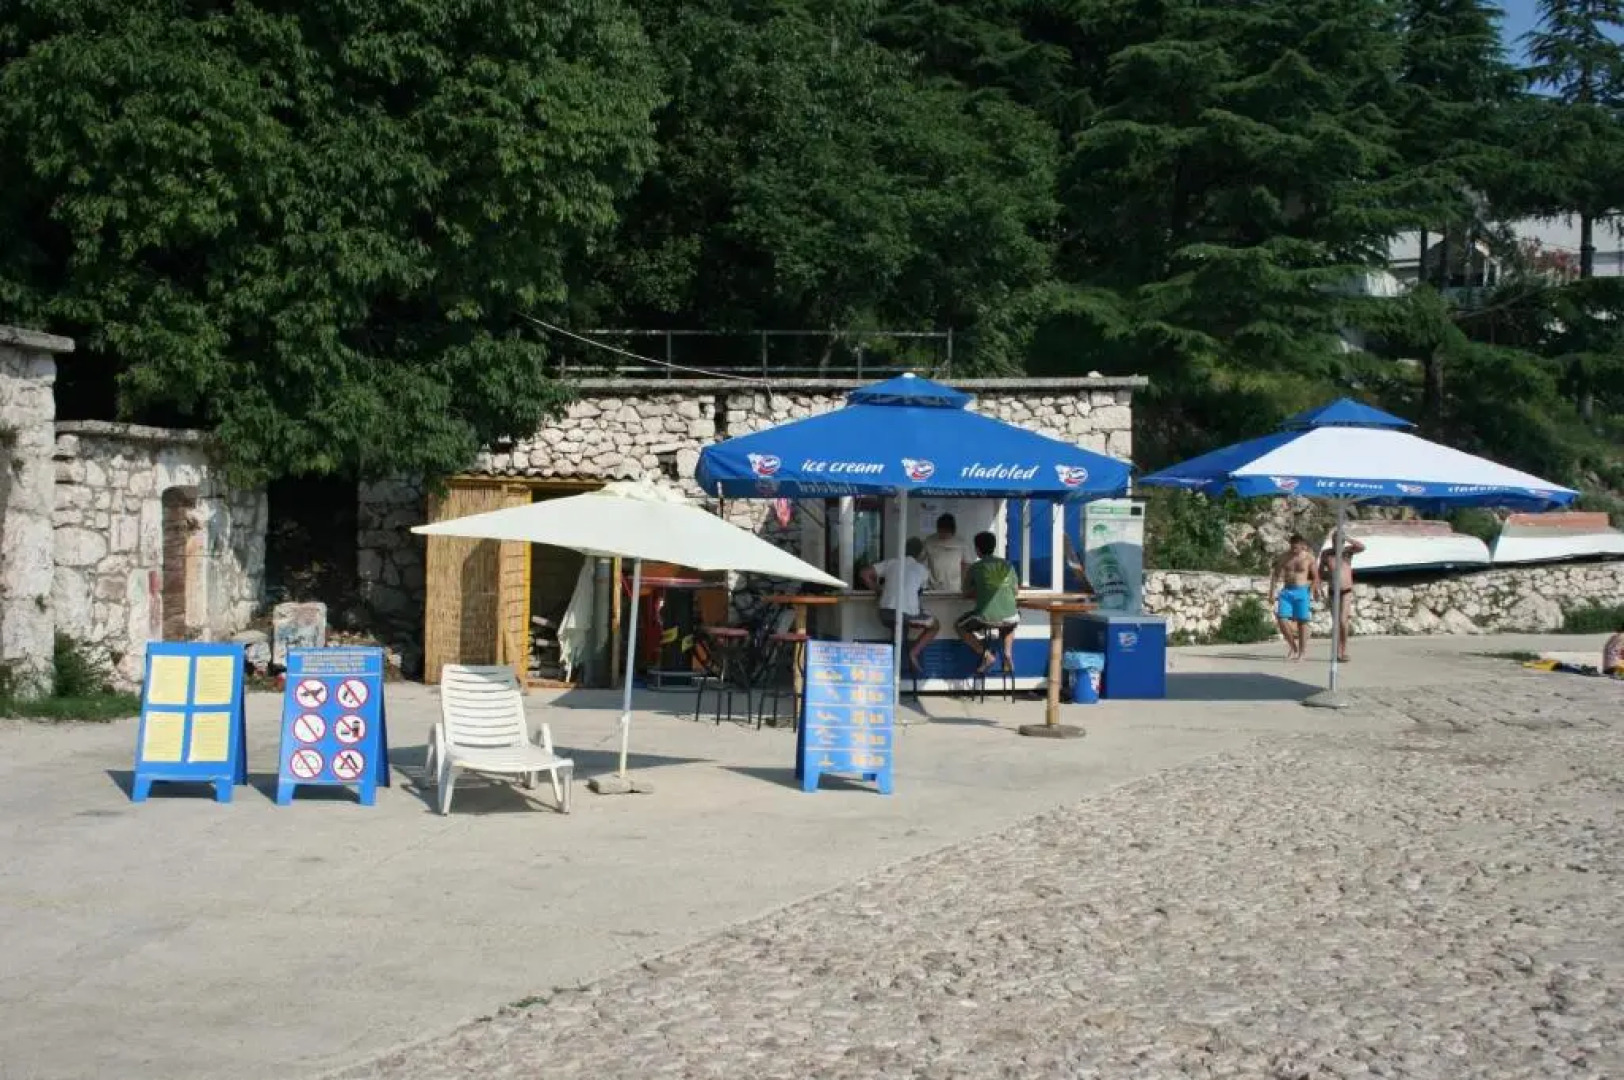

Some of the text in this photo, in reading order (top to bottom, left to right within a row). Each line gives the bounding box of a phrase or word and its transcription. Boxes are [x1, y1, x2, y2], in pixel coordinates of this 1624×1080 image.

[801, 459, 885, 475] ice cream
[960, 462, 1040, 480] sladoled
